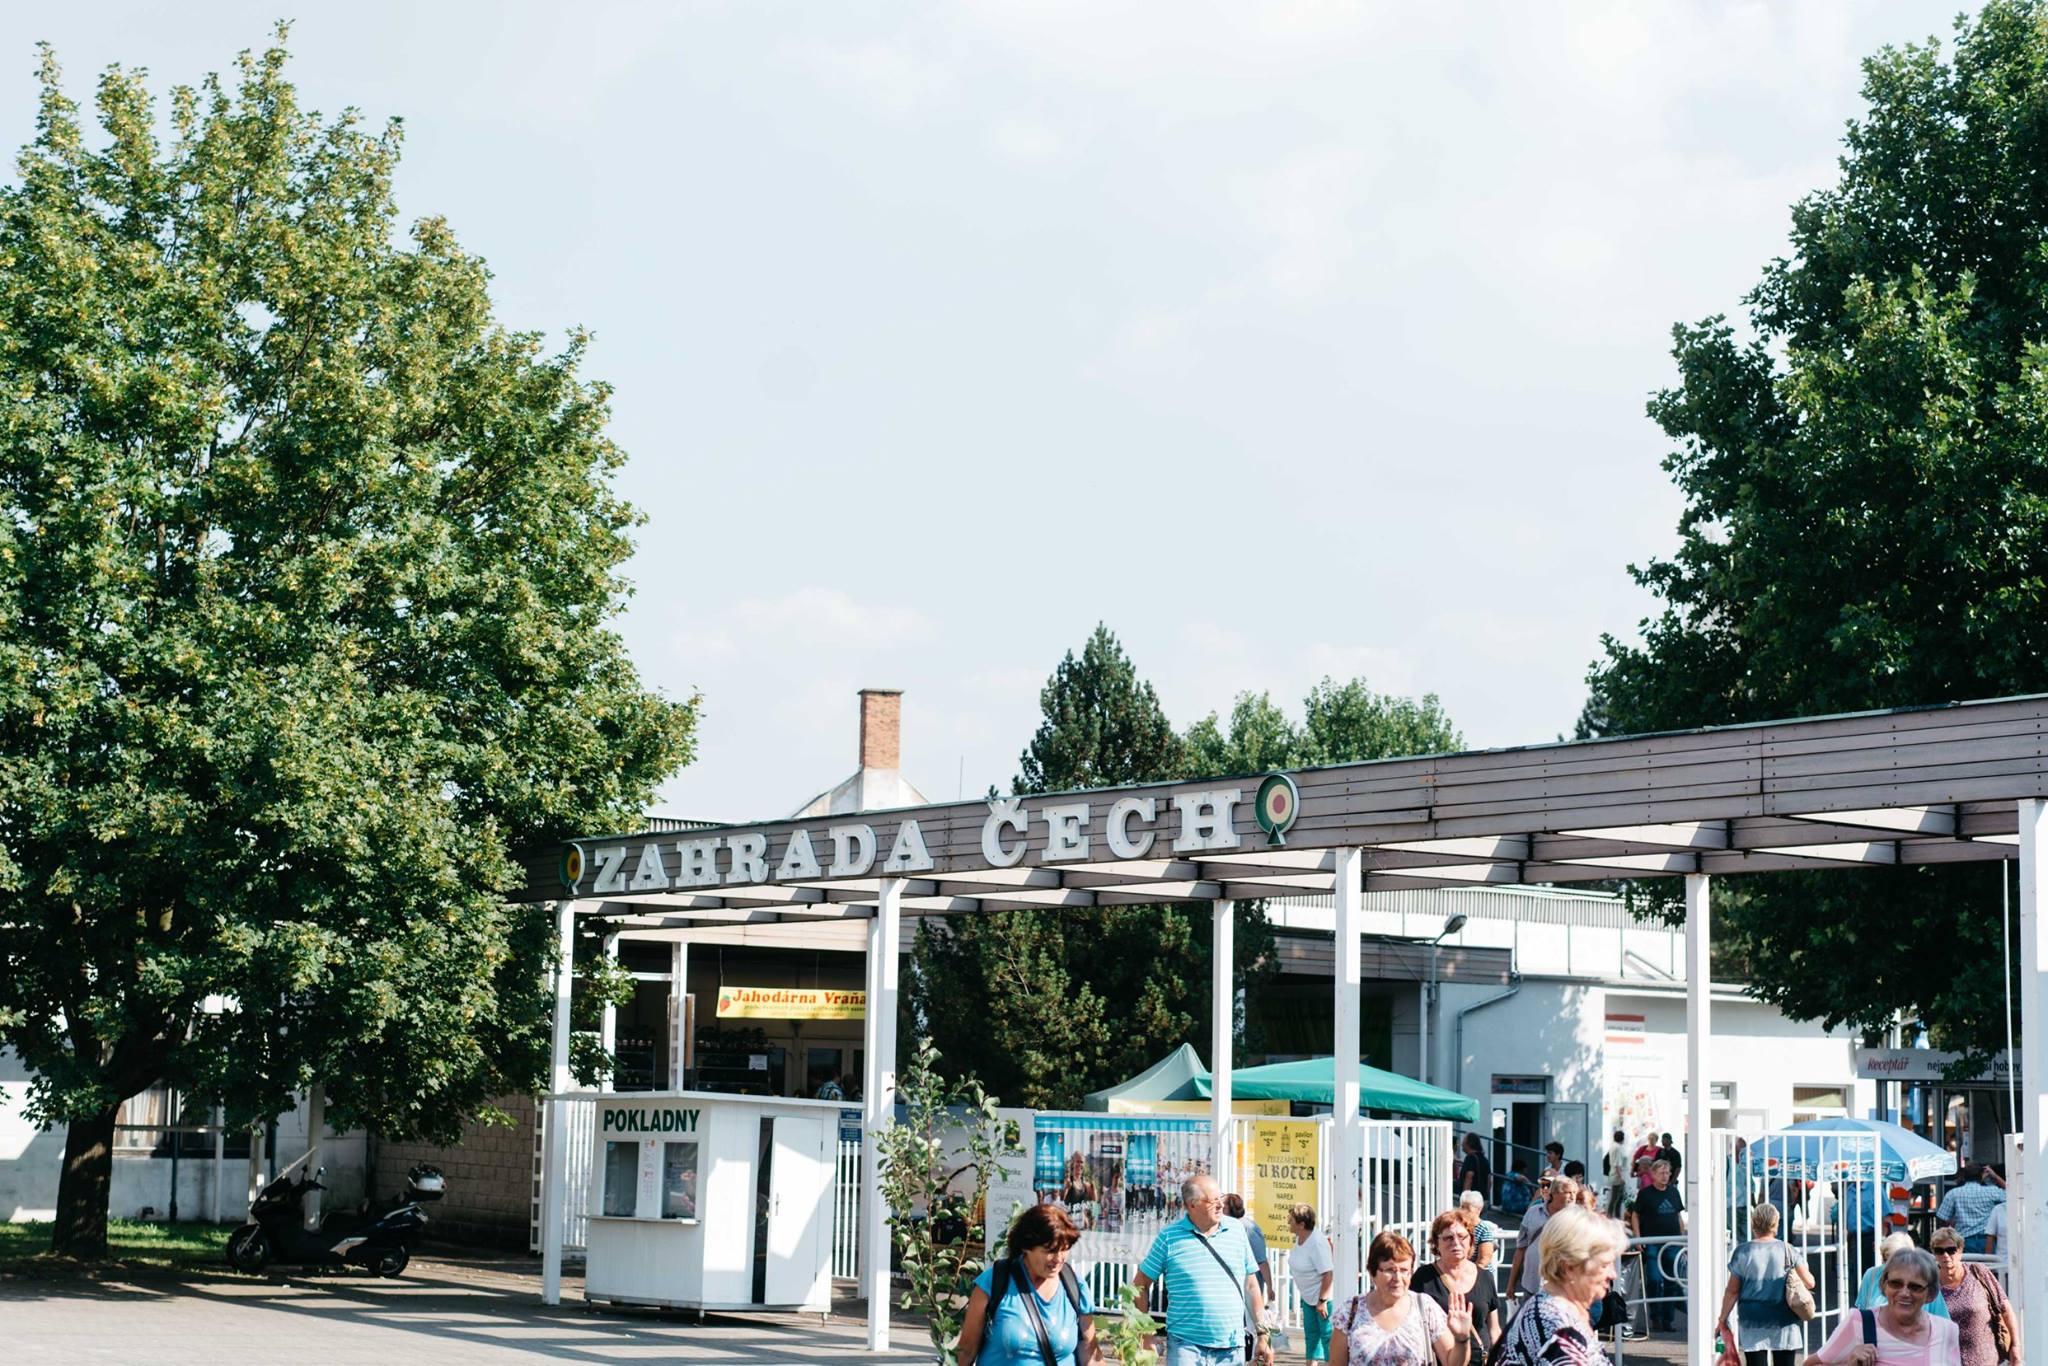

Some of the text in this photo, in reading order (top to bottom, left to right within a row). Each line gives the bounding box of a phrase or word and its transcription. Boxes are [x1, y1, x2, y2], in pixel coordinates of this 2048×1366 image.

[594, 788, 1242, 894] ZAHRADA ČECH
[733, 989, 817, 1004] Jahodárna
[1867, 1056, 1910, 1074] Receptář
[603, 1109, 701, 1132] POKLADNY
[1257, 1163, 1316, 1181] U ROTTA
